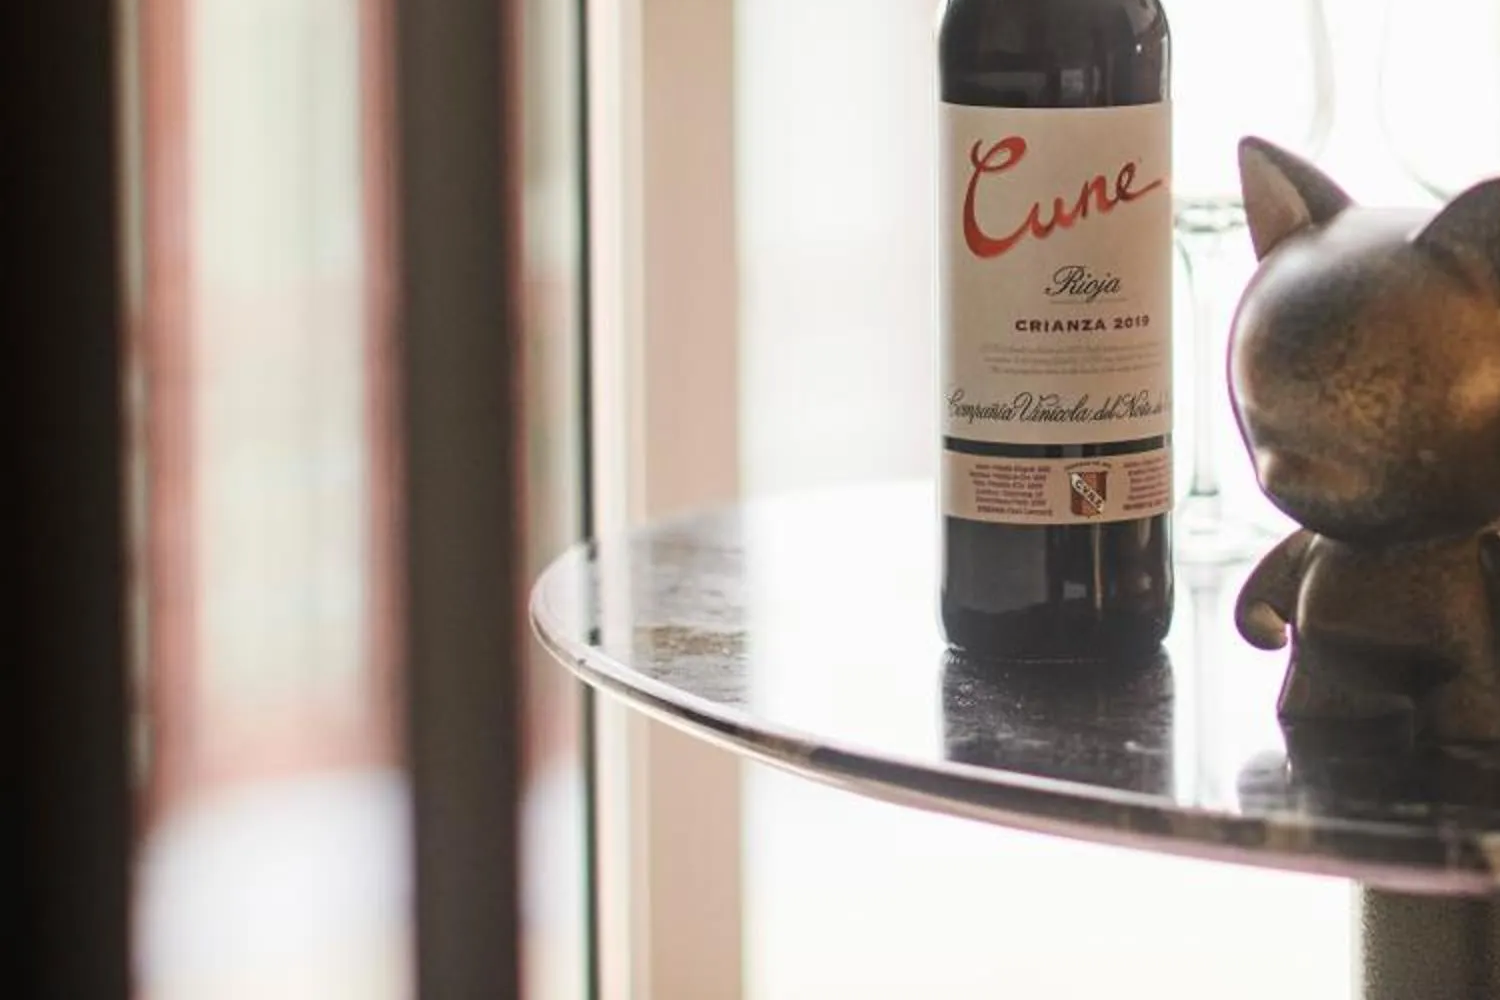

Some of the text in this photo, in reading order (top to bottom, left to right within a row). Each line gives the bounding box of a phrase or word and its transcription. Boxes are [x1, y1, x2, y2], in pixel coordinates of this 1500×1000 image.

[963, 136, 1163, 259] Cune
[1044, 265, 1121, 304] Rioja
[1015, 315, 1150, 333] CRIANZA 2019
